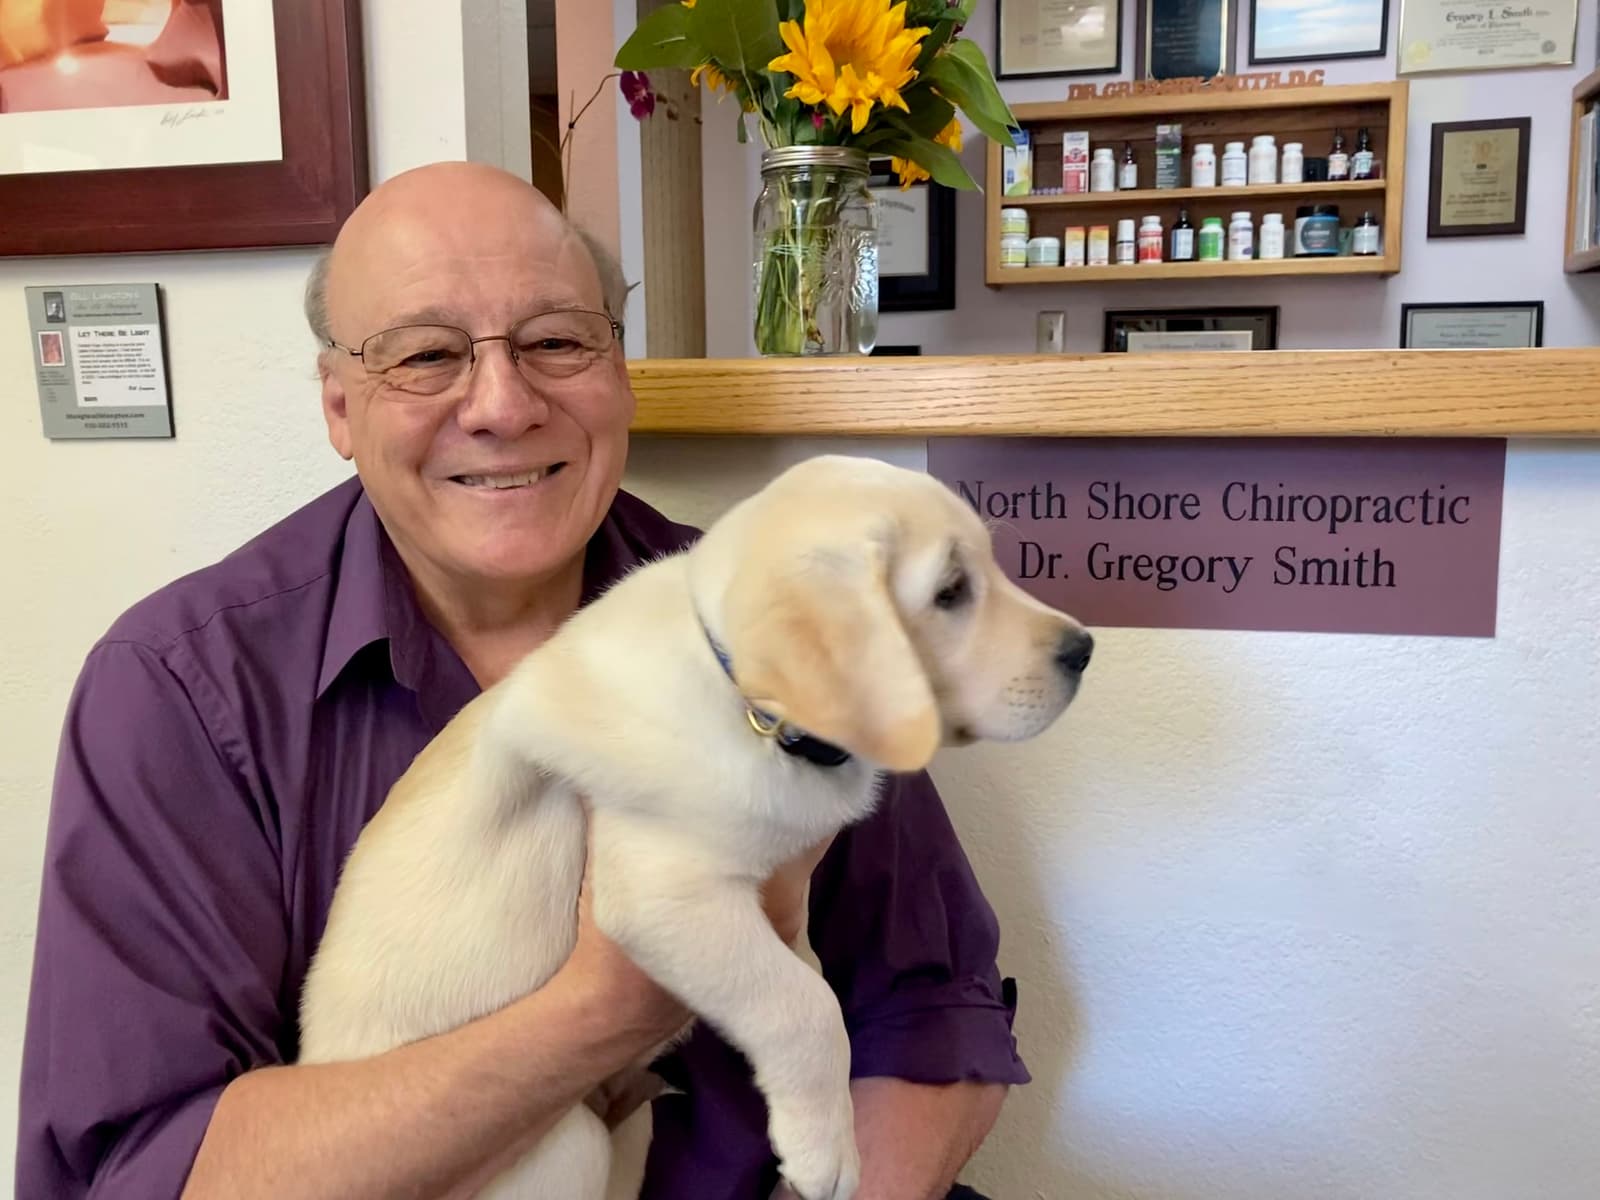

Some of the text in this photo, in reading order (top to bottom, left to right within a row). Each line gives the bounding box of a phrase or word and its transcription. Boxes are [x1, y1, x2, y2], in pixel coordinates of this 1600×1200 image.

[77, 328, 150, 338] LET THERE BE LIGHT
[957, 480, 1470, 534] North Shore Chiropractic
[1018, 541, 1397, 593] Dr. Gregory Smith
